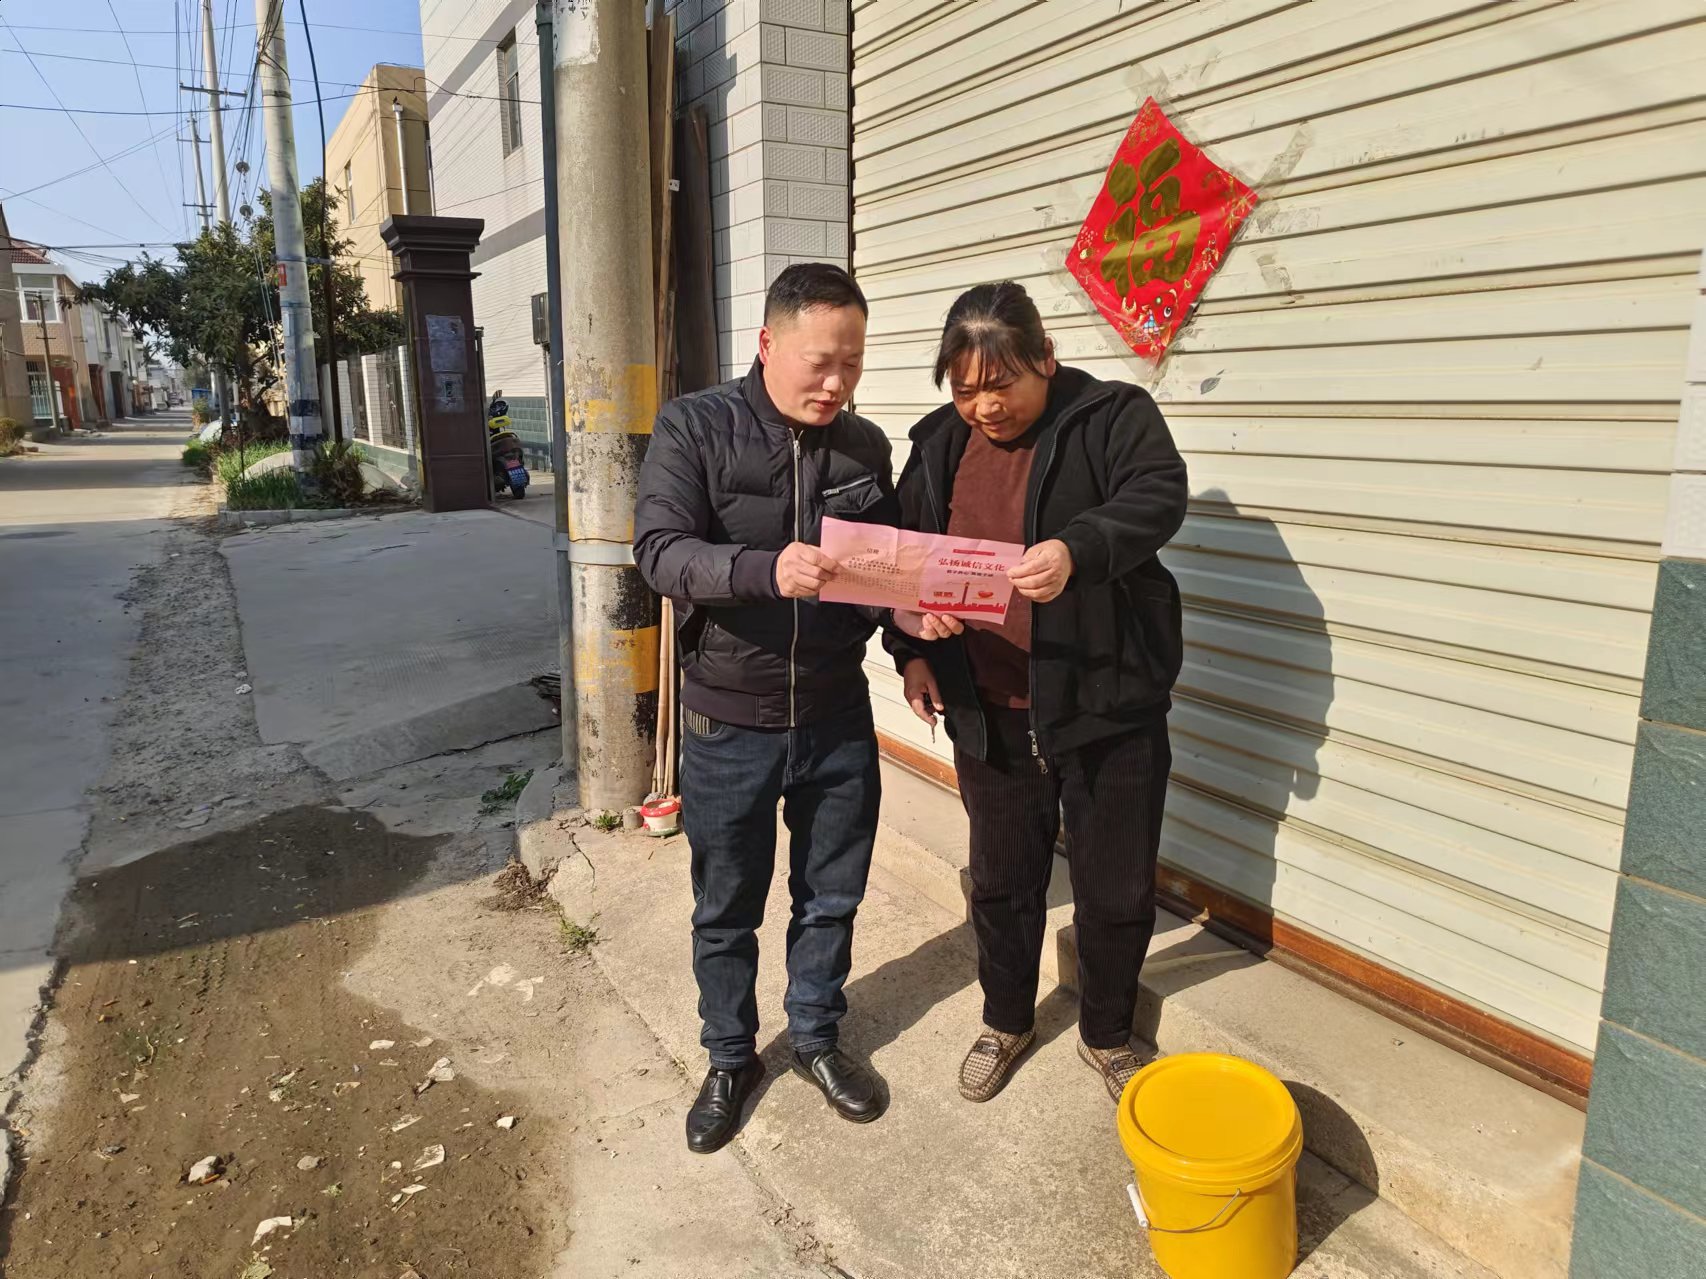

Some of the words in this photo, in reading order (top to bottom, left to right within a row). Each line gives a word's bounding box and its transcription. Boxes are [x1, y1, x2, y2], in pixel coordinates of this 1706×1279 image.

[1100, 137, 1201, 298] 福
[938, 557, 1005, 571] 弘扬诚信文化
